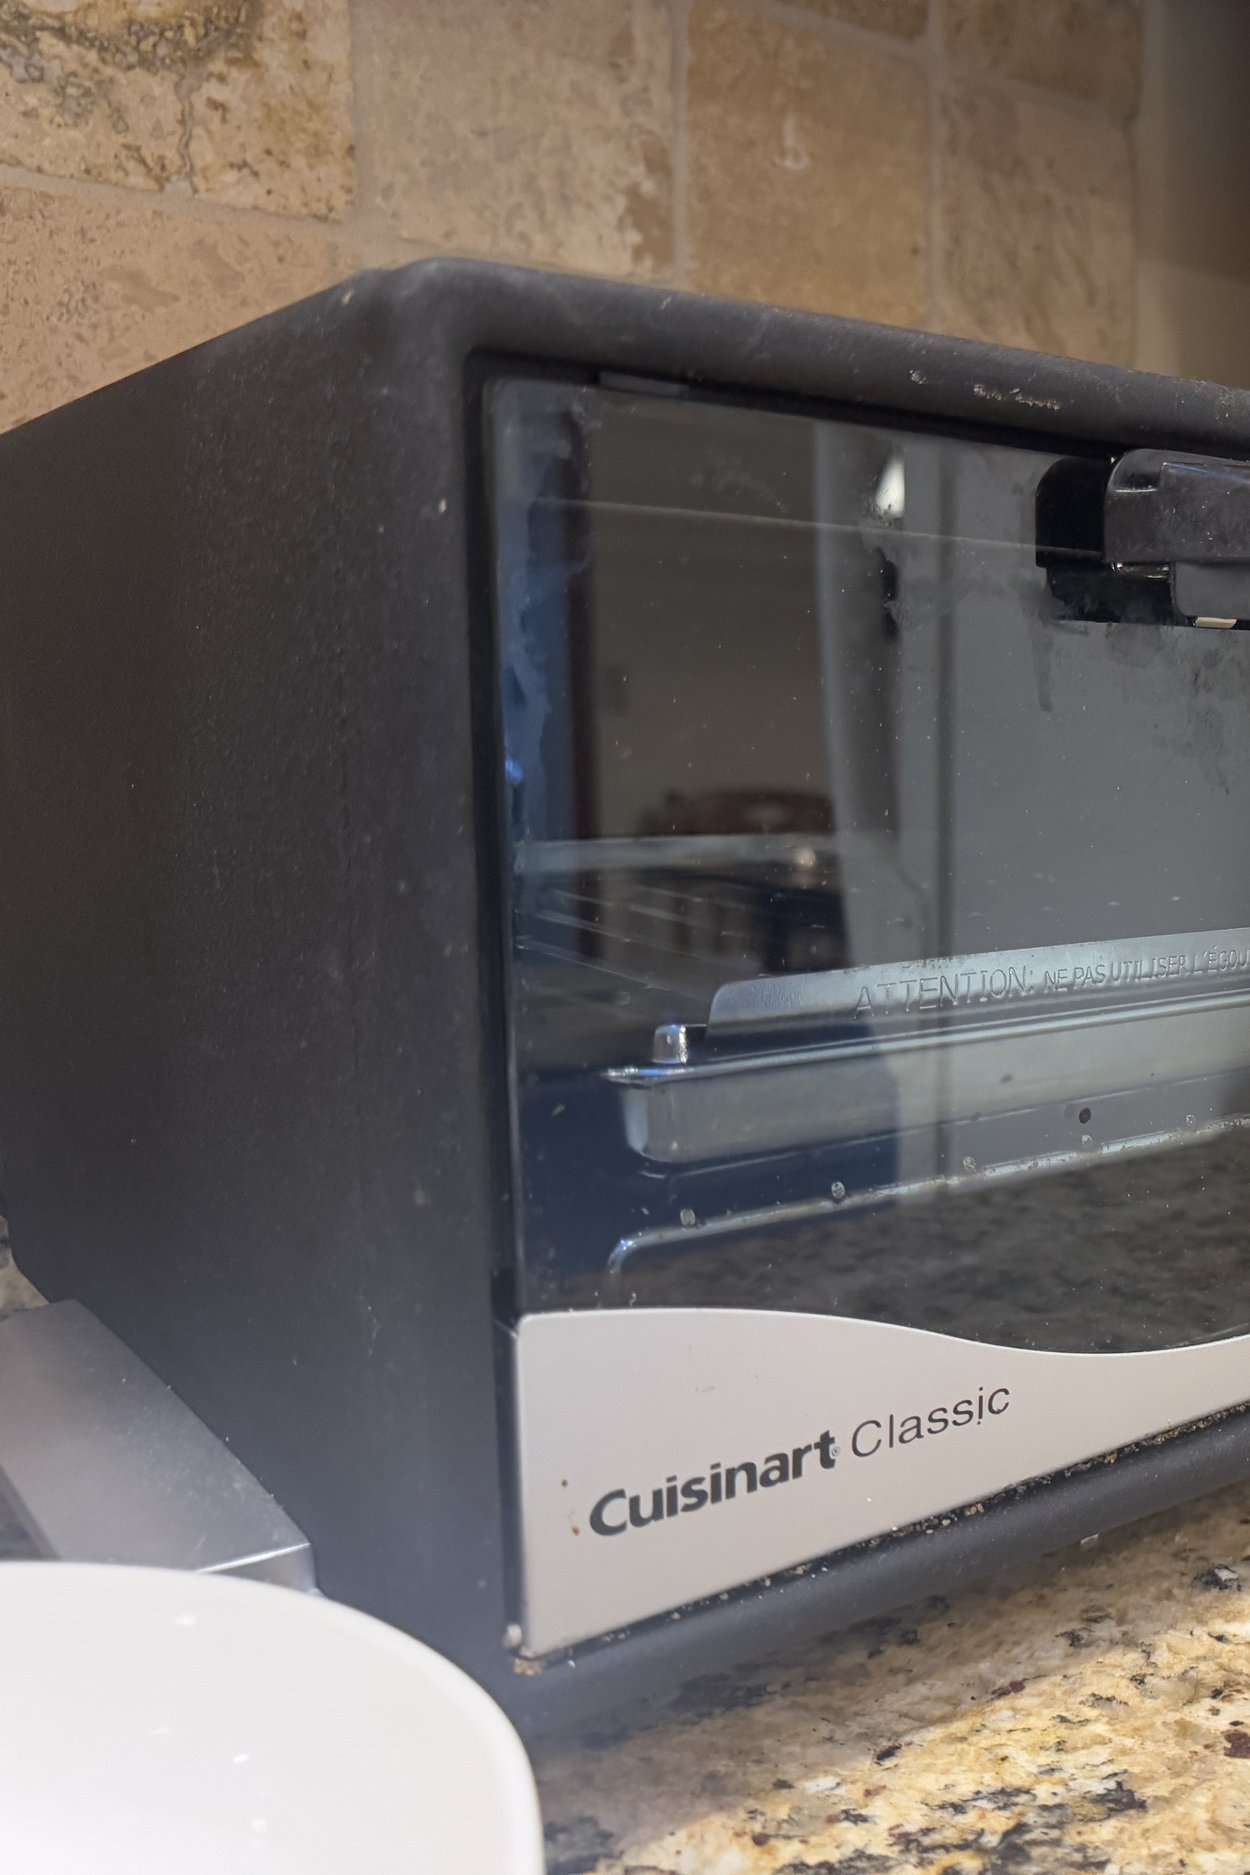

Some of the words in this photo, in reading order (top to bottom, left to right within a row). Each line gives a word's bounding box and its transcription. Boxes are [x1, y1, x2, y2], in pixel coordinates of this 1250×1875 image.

[853, 965, 1034, 1020] ATTENTION:
[1044, 967, 1068, 993] NE
[1073, 963, 1105, 990] PAS
[1110, 955, 1190, 985] UTILISER
[589, 1429, 836, 1536] Cuisinart
[851, 1386, 1010, 1458] Classic
